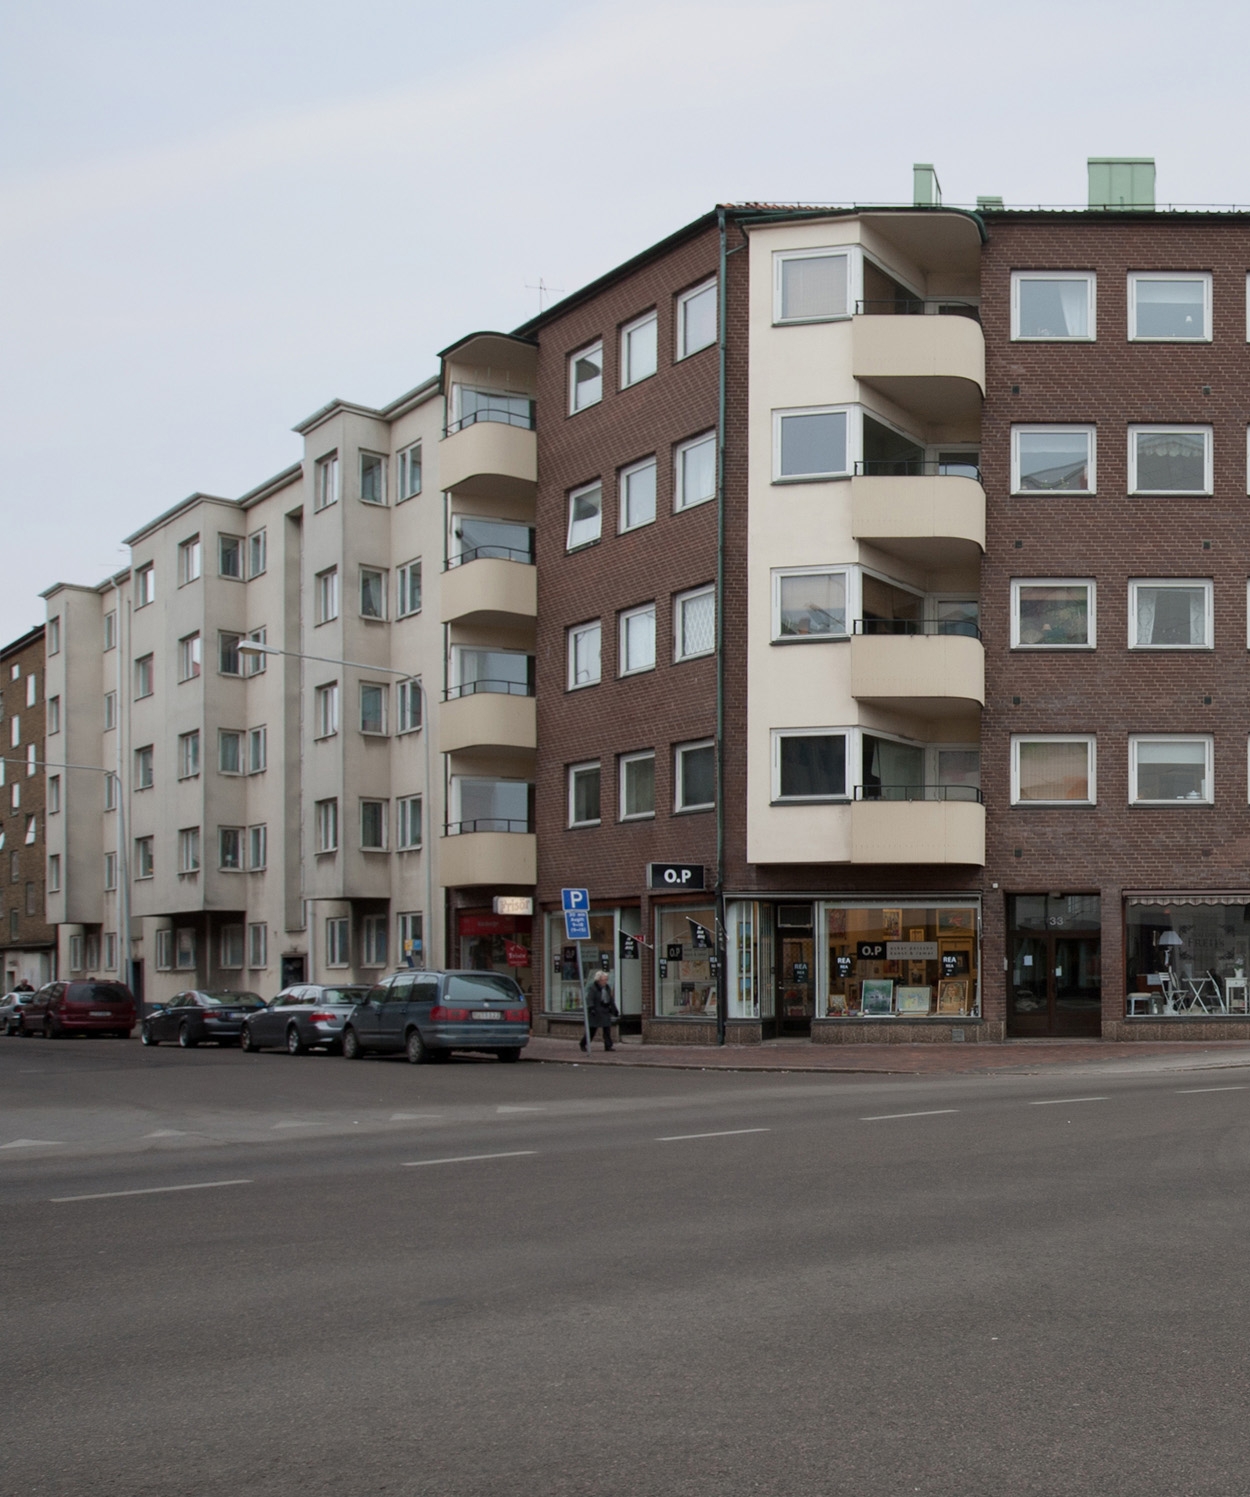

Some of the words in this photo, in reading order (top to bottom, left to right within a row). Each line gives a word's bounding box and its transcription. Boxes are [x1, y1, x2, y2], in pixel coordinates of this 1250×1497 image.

[664, 868, 692, 883] O.P
[571, 891, 583, 908] P
[1049, 916, 1064, 926] 33
[862, 945, 882, 956] O.P
